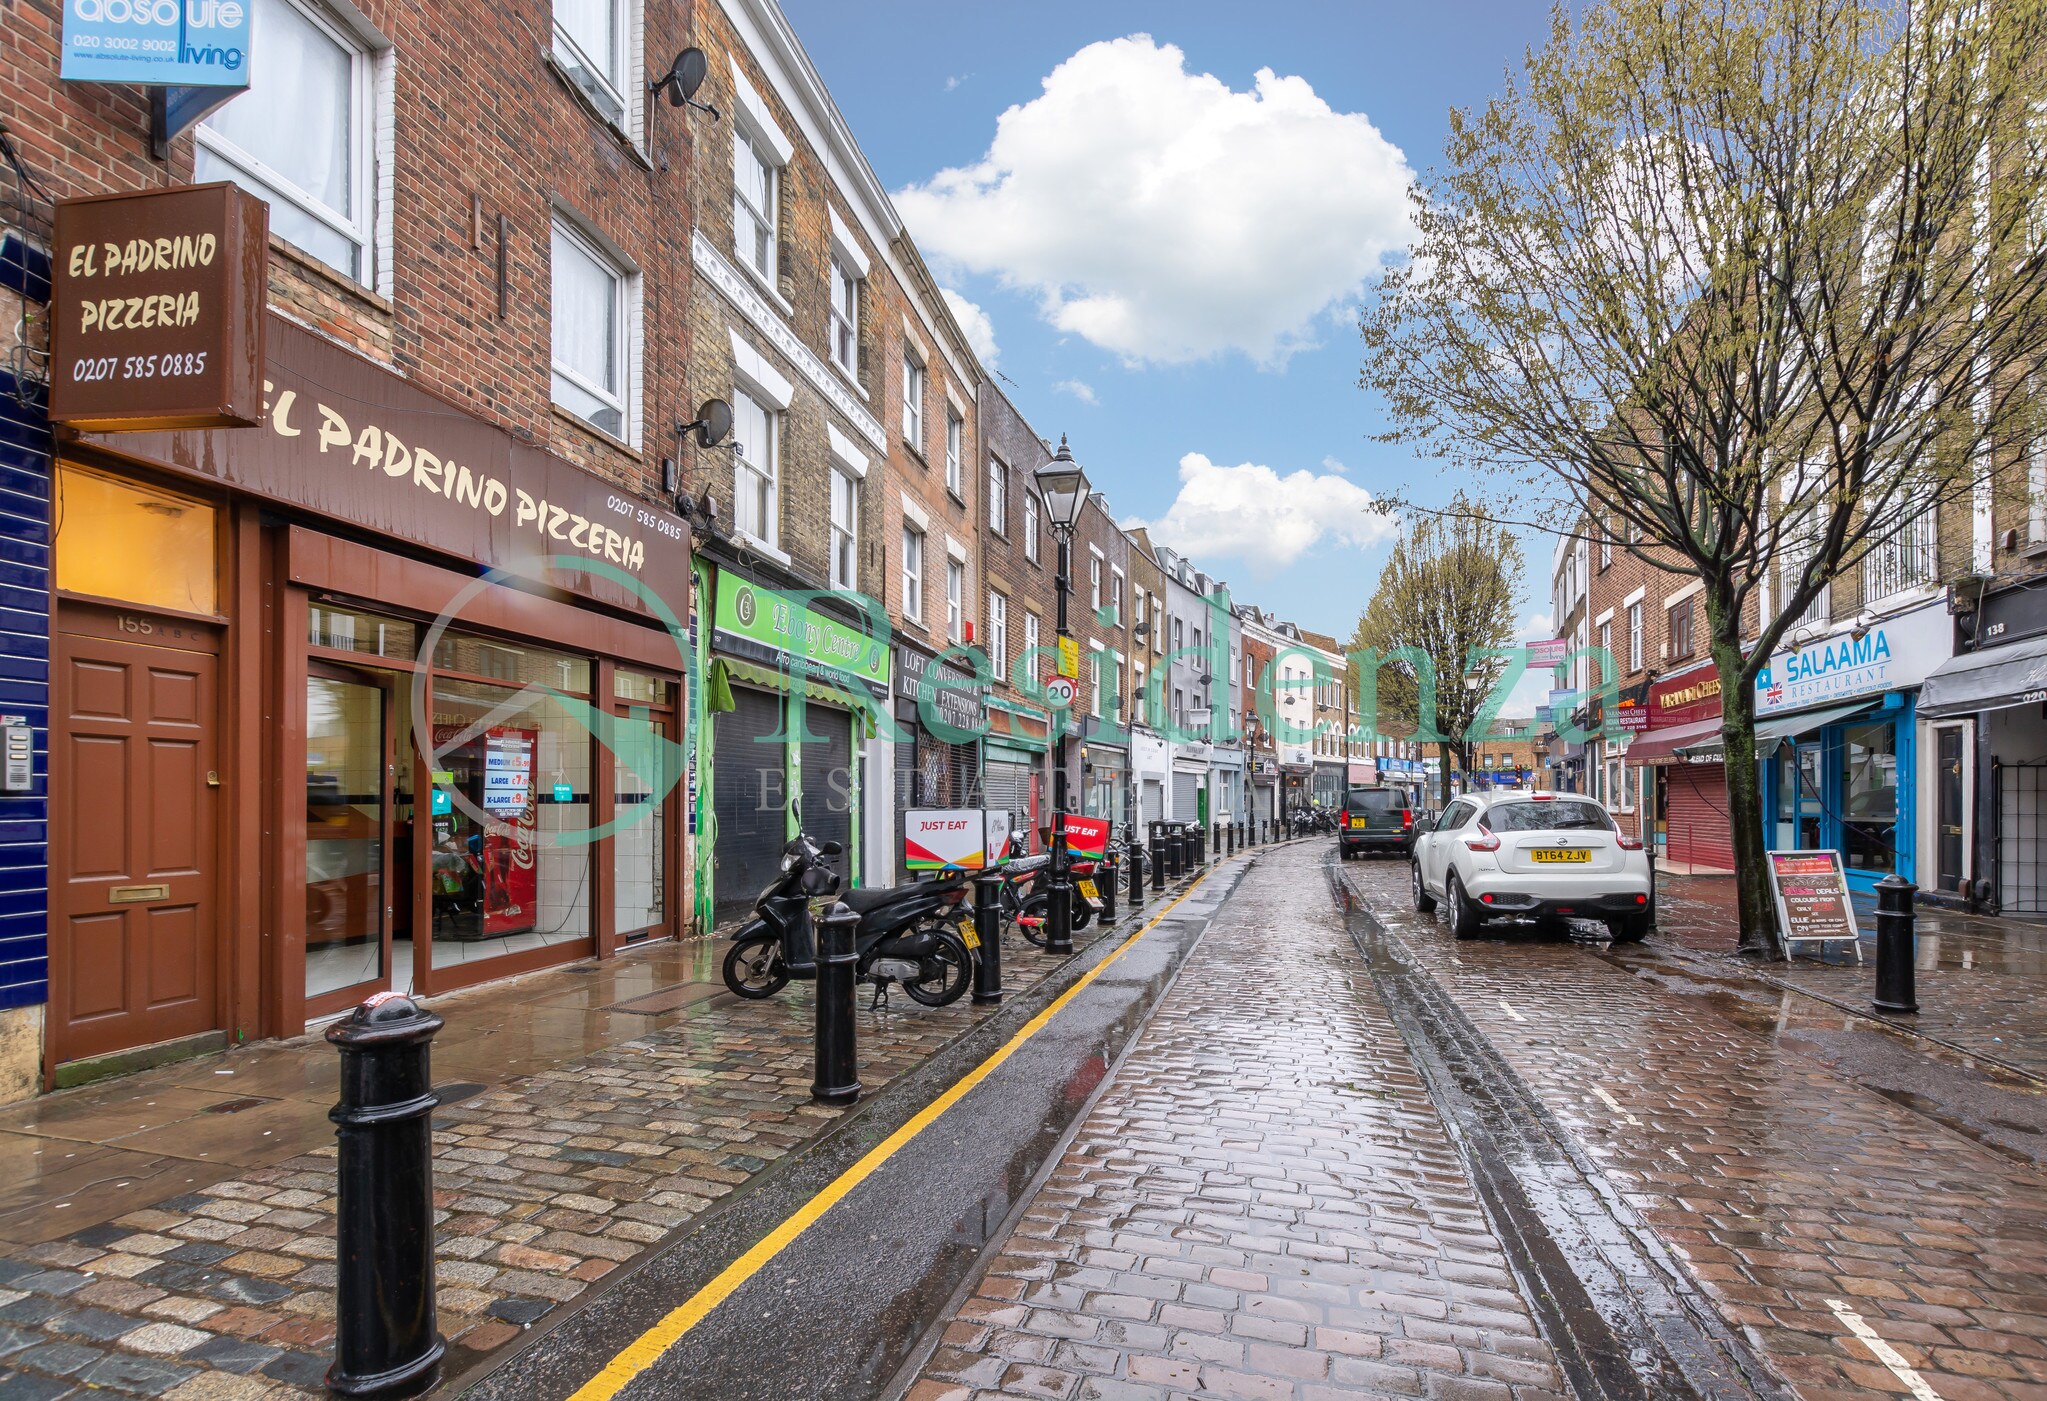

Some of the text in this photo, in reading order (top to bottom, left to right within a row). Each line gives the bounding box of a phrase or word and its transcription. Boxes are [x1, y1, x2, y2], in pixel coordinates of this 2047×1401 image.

[73, 35, 177, 52] 020 3002 9002
[73, 52, 175, 63] www.absolute-living.co.uk
[178, 43, 242, 71] living
[69, 233, 216, 277] EL PADRINO
[81, 291, 200, 334] PIZZERIA
[74, 352, 207, 382] 0207 585 0885
[317, 403, 507, 516] PADRINO
[516, 487, 645, 571] PIZZERIA
[606, 494, 682, 541] 0207 585 0885
[117, 615, 152, 635] 155
[772, 603, 820, 655] Ebony
[822, 625, 861, 662] Centre
[1987, 623, 2004, 636] 138
[775, 651, 790, 665] Afro
[825, 666, 839, 680] world
[1786, 630, 1891, 682] SALAAMA
[904, 650, 926, 674] LOFT
[927, 661, 972, 693] CONVERSIONS
[1791, 666, 1886, 698] RESTAURANT
[903, 676, 977, 716] KITCHEN EXTENSIONS
[1049, 686, 1071, 699] 20
[1660, 687, 1697, 708] VARANASI
[939, 707, 955, 725] 0207
[958, 713, 969, 729] 228
[1606, 709, 1630, 717] VARANASI
[1630, 708, 1647, 716] CHEFS
[1620, 717, 1647, 725] RESTAURANT
[489, 758, 511, 766] MEDIUM
[920, 821, 968, 831] JUST EAT
[1064, 825, 1098, 837] UST EAT
[1536, 851, 1587, 860] BT64 ZJV
[1816, 887, 1840, 895] DEALS
